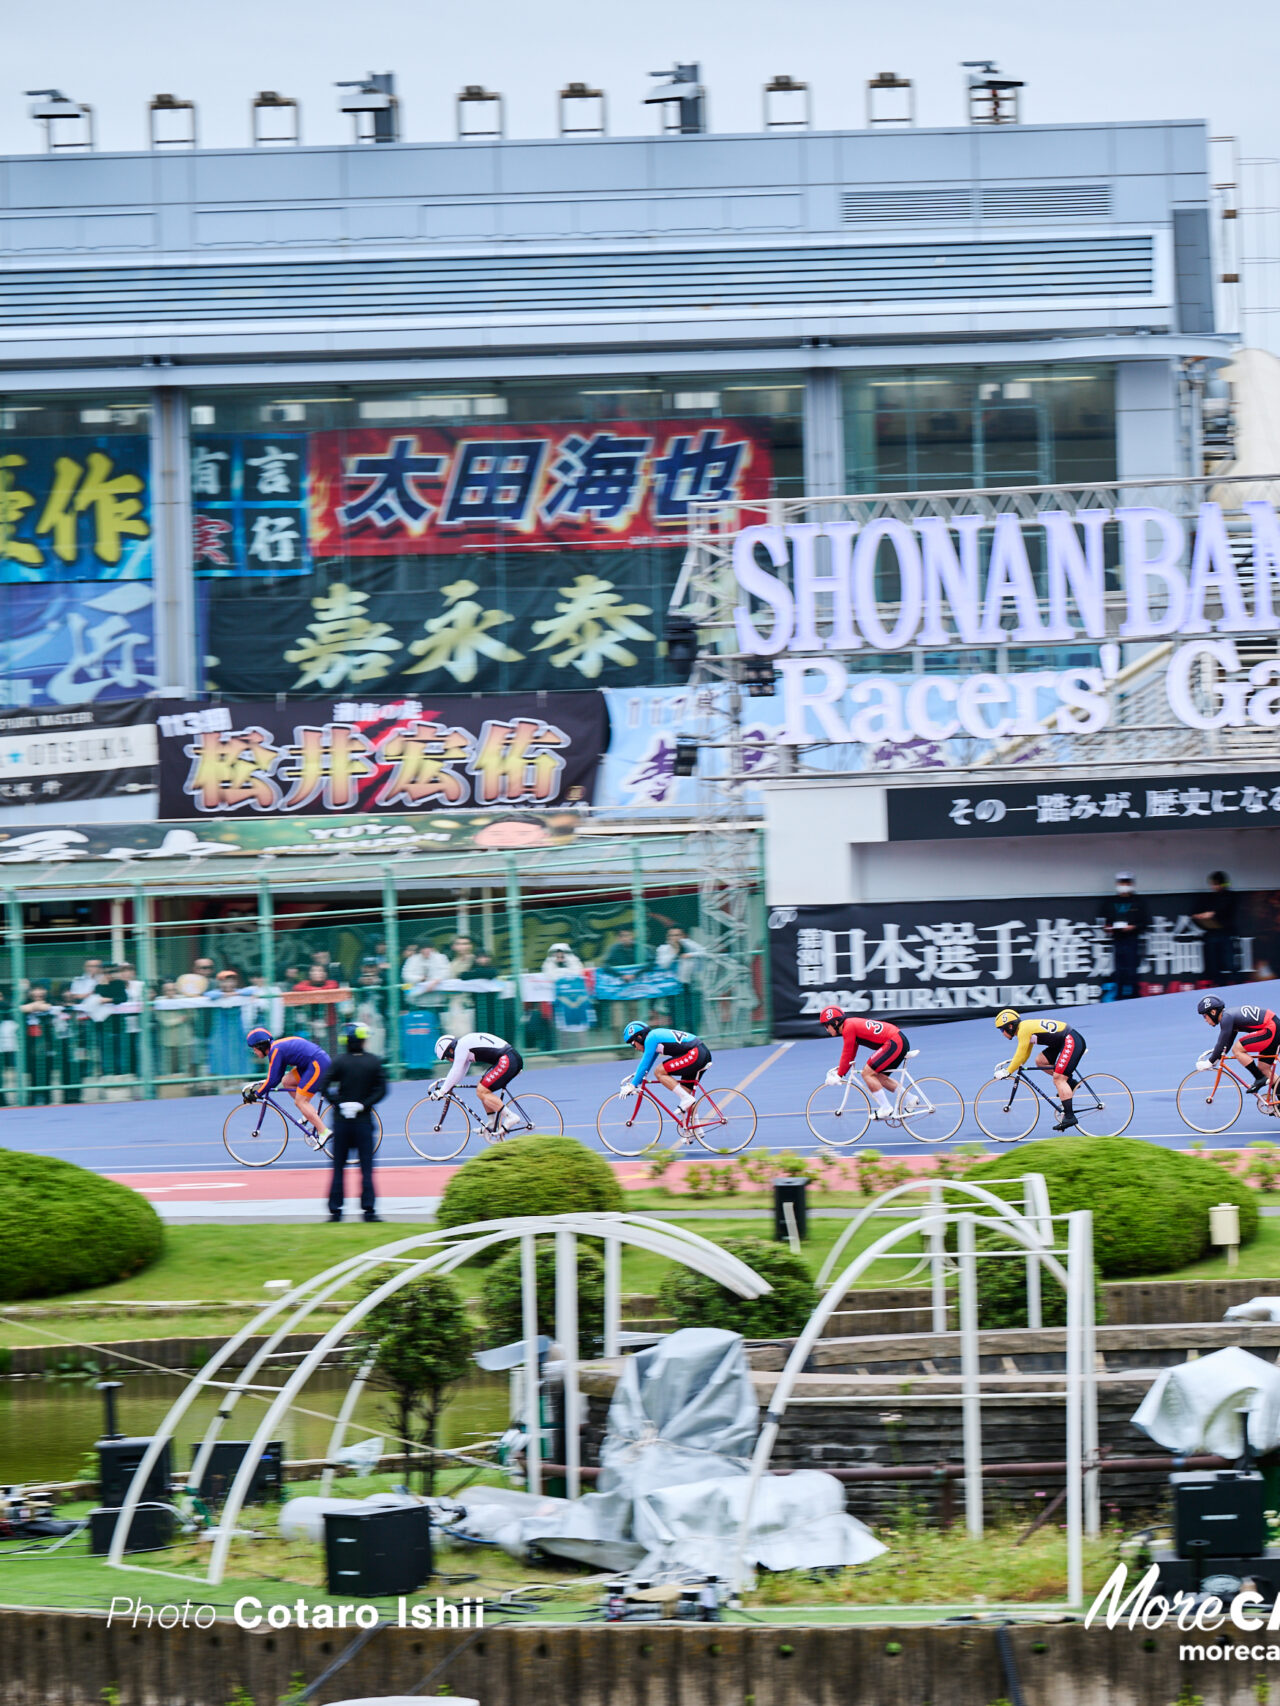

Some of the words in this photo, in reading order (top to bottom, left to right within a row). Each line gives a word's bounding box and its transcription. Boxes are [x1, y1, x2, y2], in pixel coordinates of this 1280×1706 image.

[338, 430, 750, 526] 太田海也
[733, 508, 1111, 657] SHONAN
[775, 643, 1122, 745] Racers'
[183, 717, 571, 813] 松井宏佑
[865, 1019, 884, 1035] 3
[870, 984, 1056, 1012] HIRATSUKA
[1039, 1018, 1059, 1034] 5
[1241, 1006, 1260, 1021] 2
